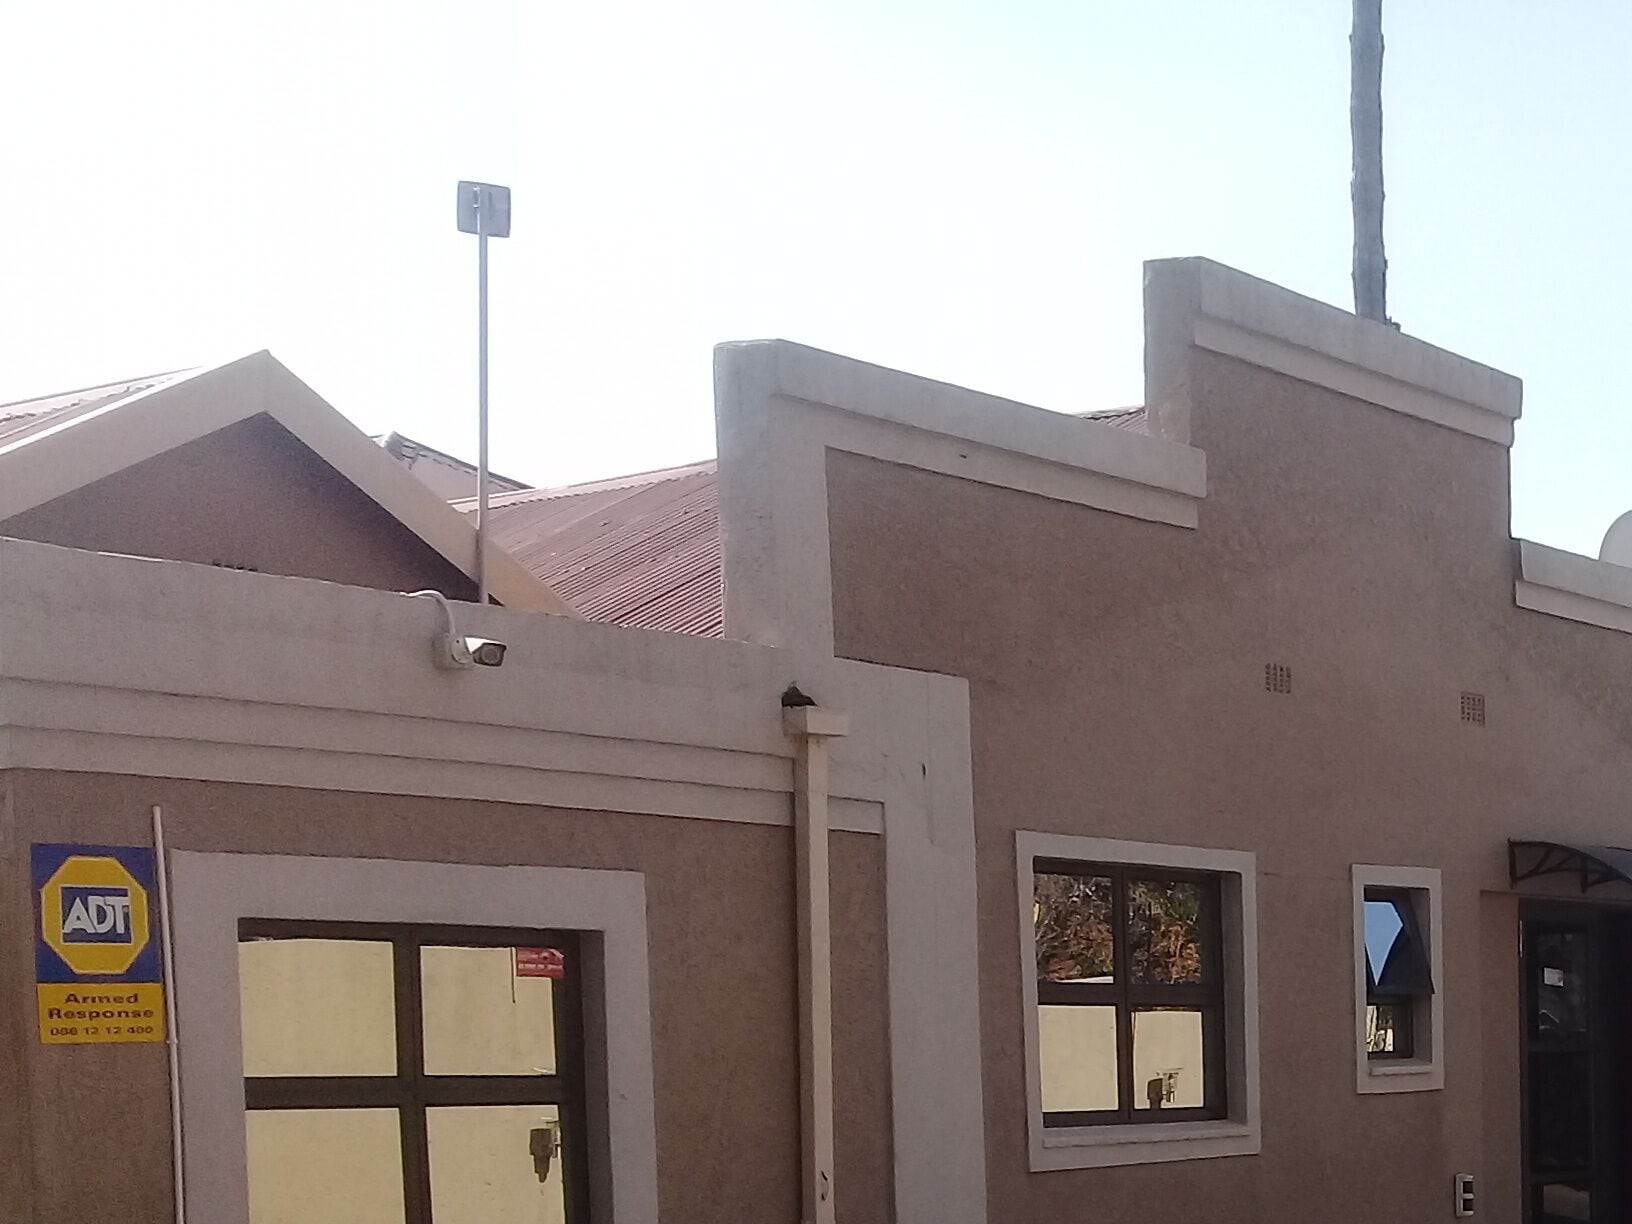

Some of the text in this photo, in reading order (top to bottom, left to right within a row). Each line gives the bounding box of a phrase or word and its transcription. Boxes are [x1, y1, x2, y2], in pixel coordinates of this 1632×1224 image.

[62, 897, 129, 933] ADT
[65, 993, 138, 1004] Armed
[48, 1008, 154, 1021] Response
